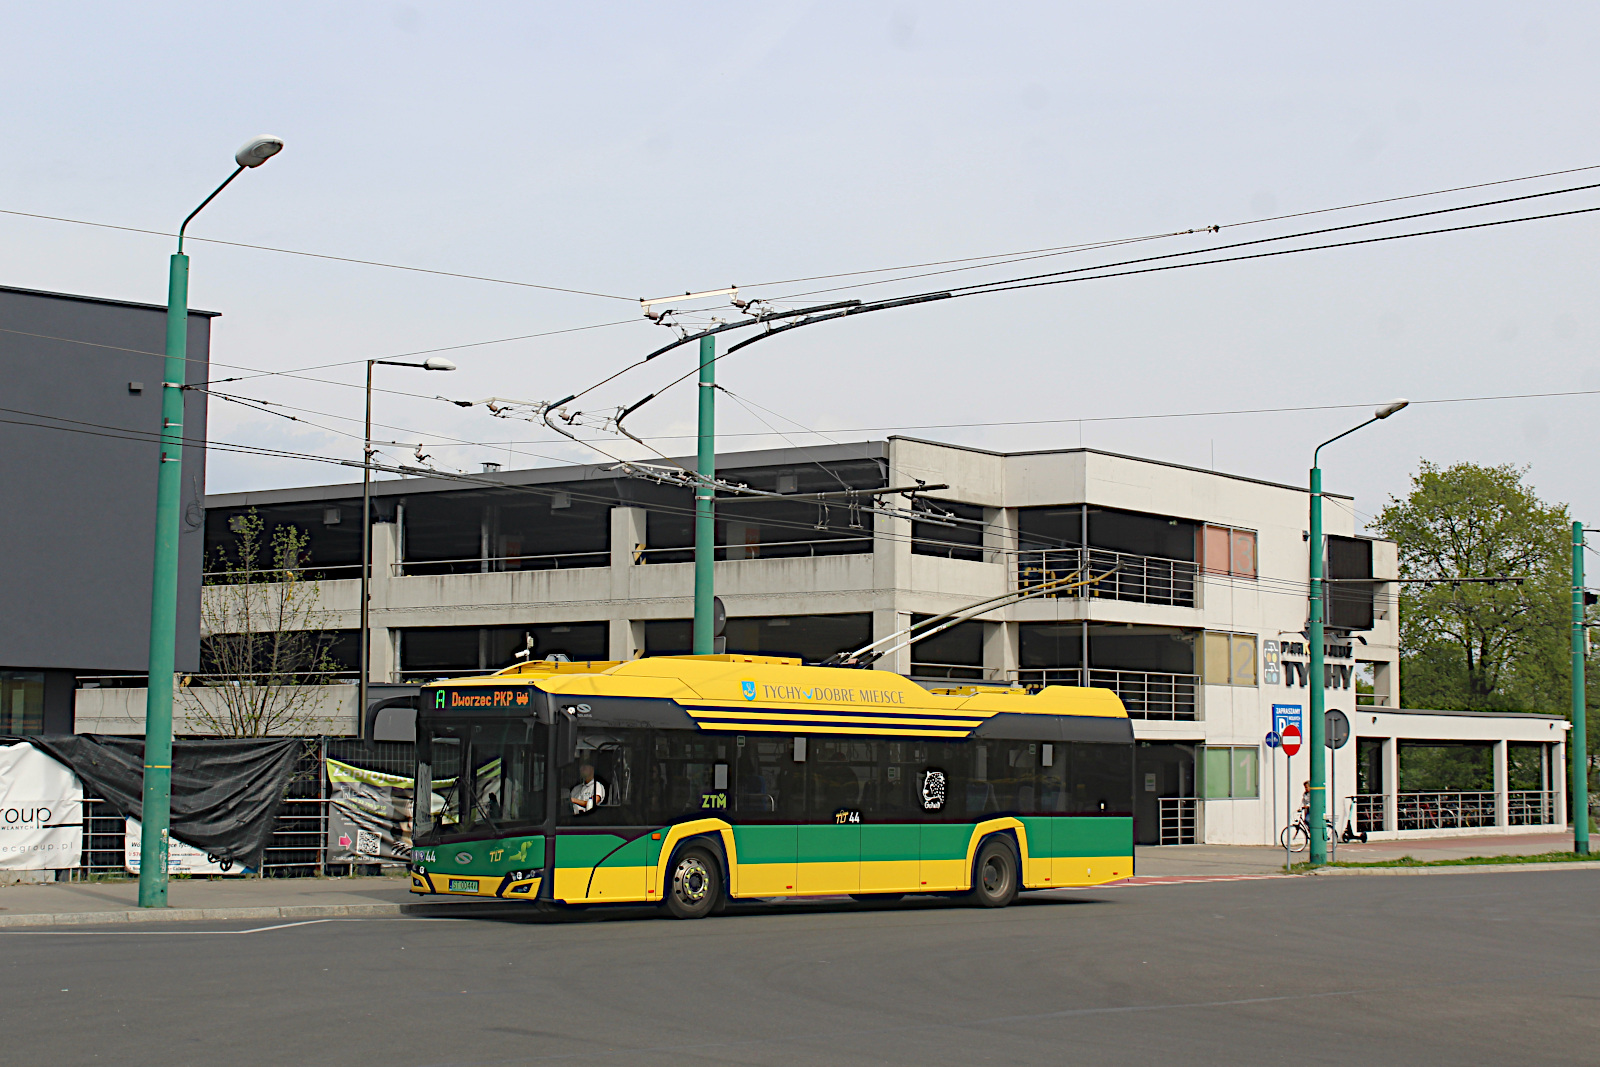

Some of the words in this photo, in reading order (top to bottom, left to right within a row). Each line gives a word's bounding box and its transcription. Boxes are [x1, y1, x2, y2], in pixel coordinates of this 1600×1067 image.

[1236, 536, 1253, 573] 3
[1281, 641, 1310, 656] PARK
[1236, 641, 1254, 679] 2
[1281, 661, 1354, 690] TYHY
[435, 689, 446, 709] A
[451, 691, 491, 707] Dworzec
[493, 691, 514, 707] PKP
[763, 684, 802, 700] TYCHY
[814, 687, 855, 702] DOBRE
[859, 690, 905, 704] MIEJSCE
[1240, 753, 1251, 791] 1
[702, 792, 727, 808] ZTM
[849, 811, 860, 824] 44
[425, 850, 437, 863] 44
